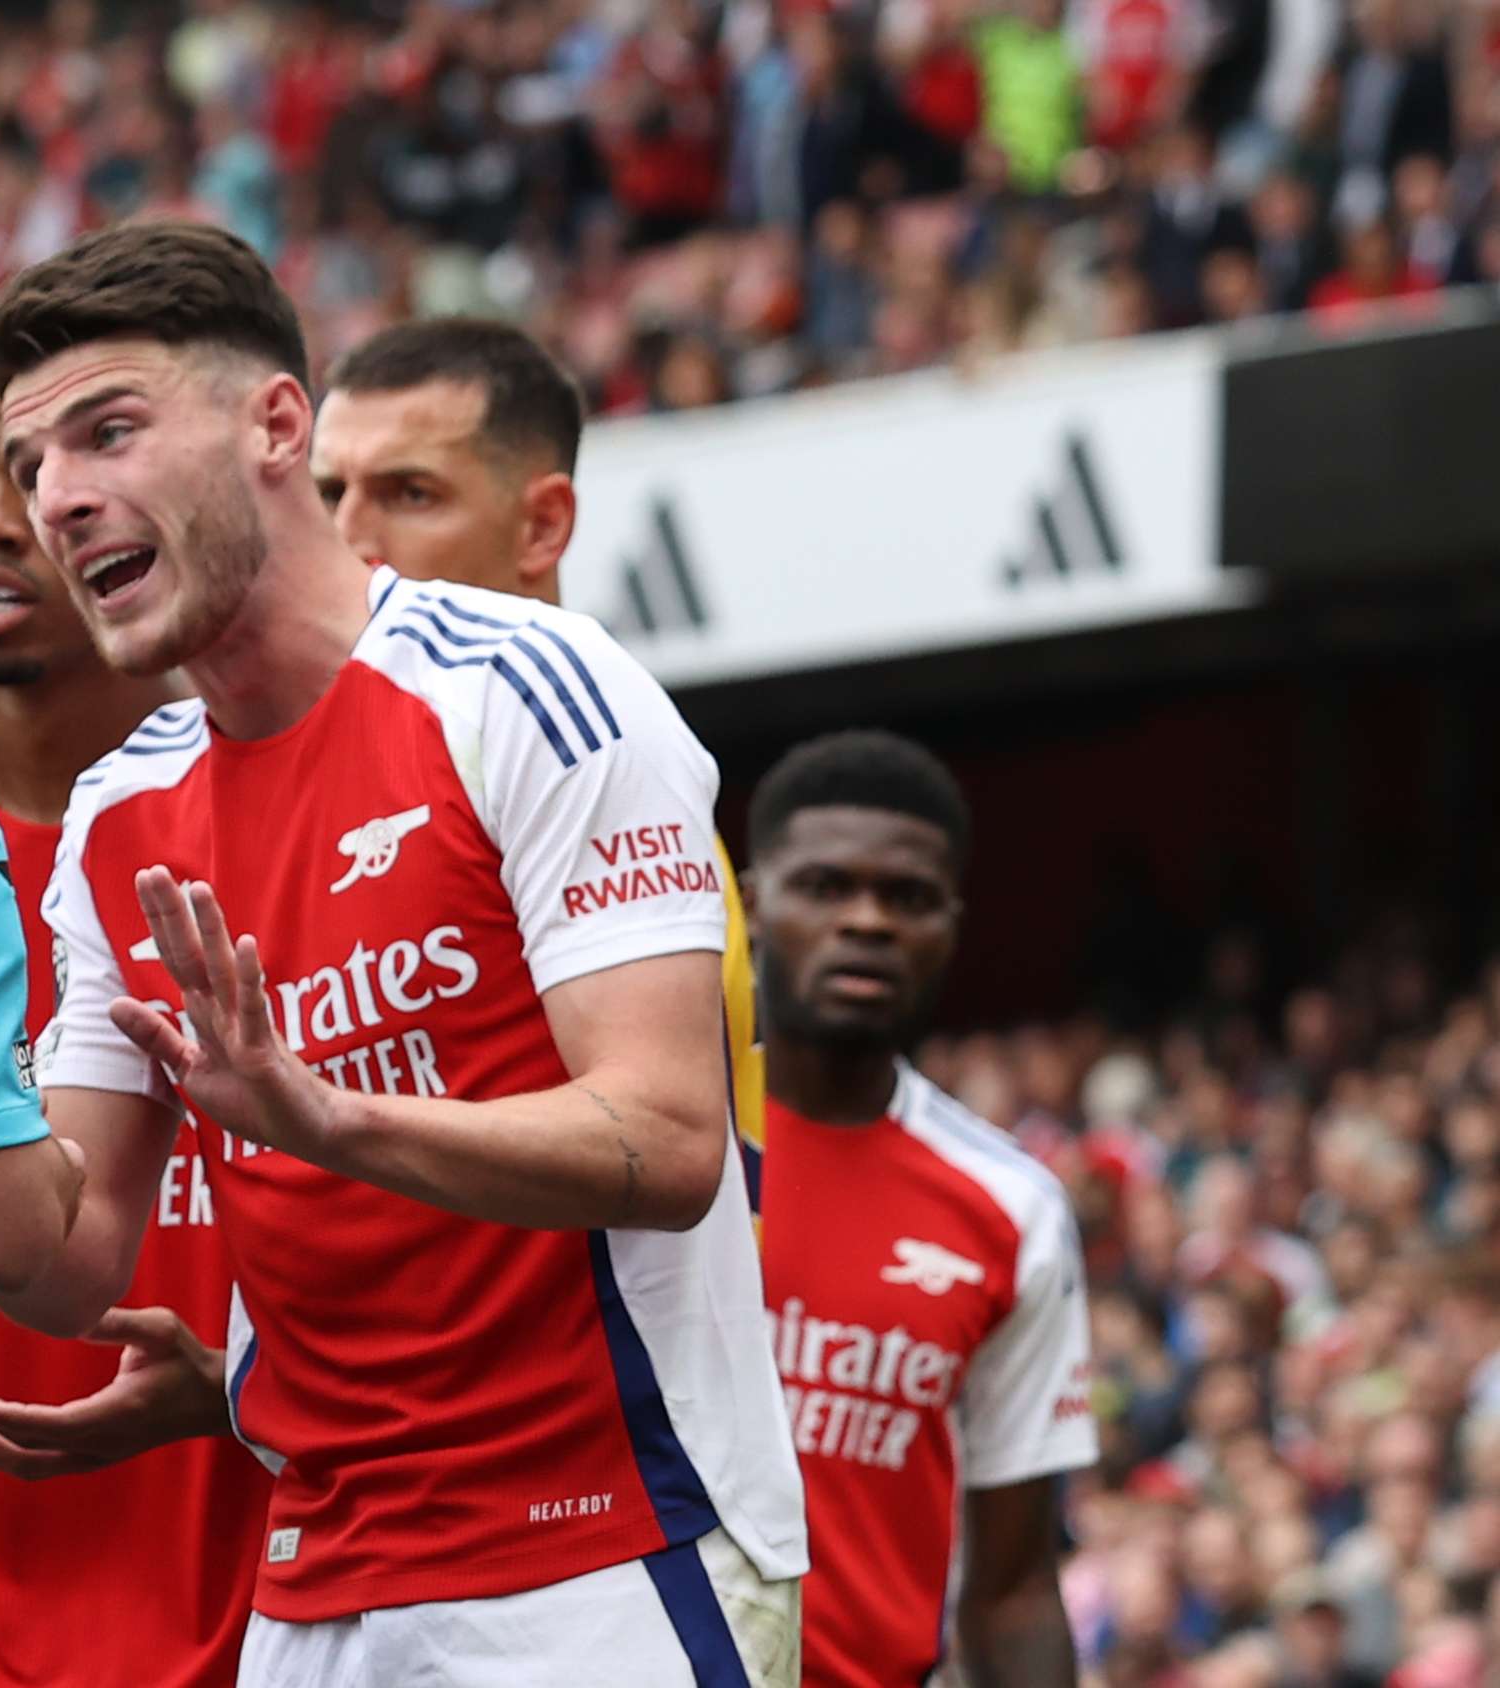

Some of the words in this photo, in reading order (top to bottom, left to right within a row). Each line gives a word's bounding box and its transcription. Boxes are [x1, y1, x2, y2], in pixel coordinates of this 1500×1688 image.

[590, 823, 683, 866] VISIT
[562, 860, 720, 918] RWANDA
[145, 925, 479, 1051] rates
[529, 1493, 613, 1522] HEAT.RDY
